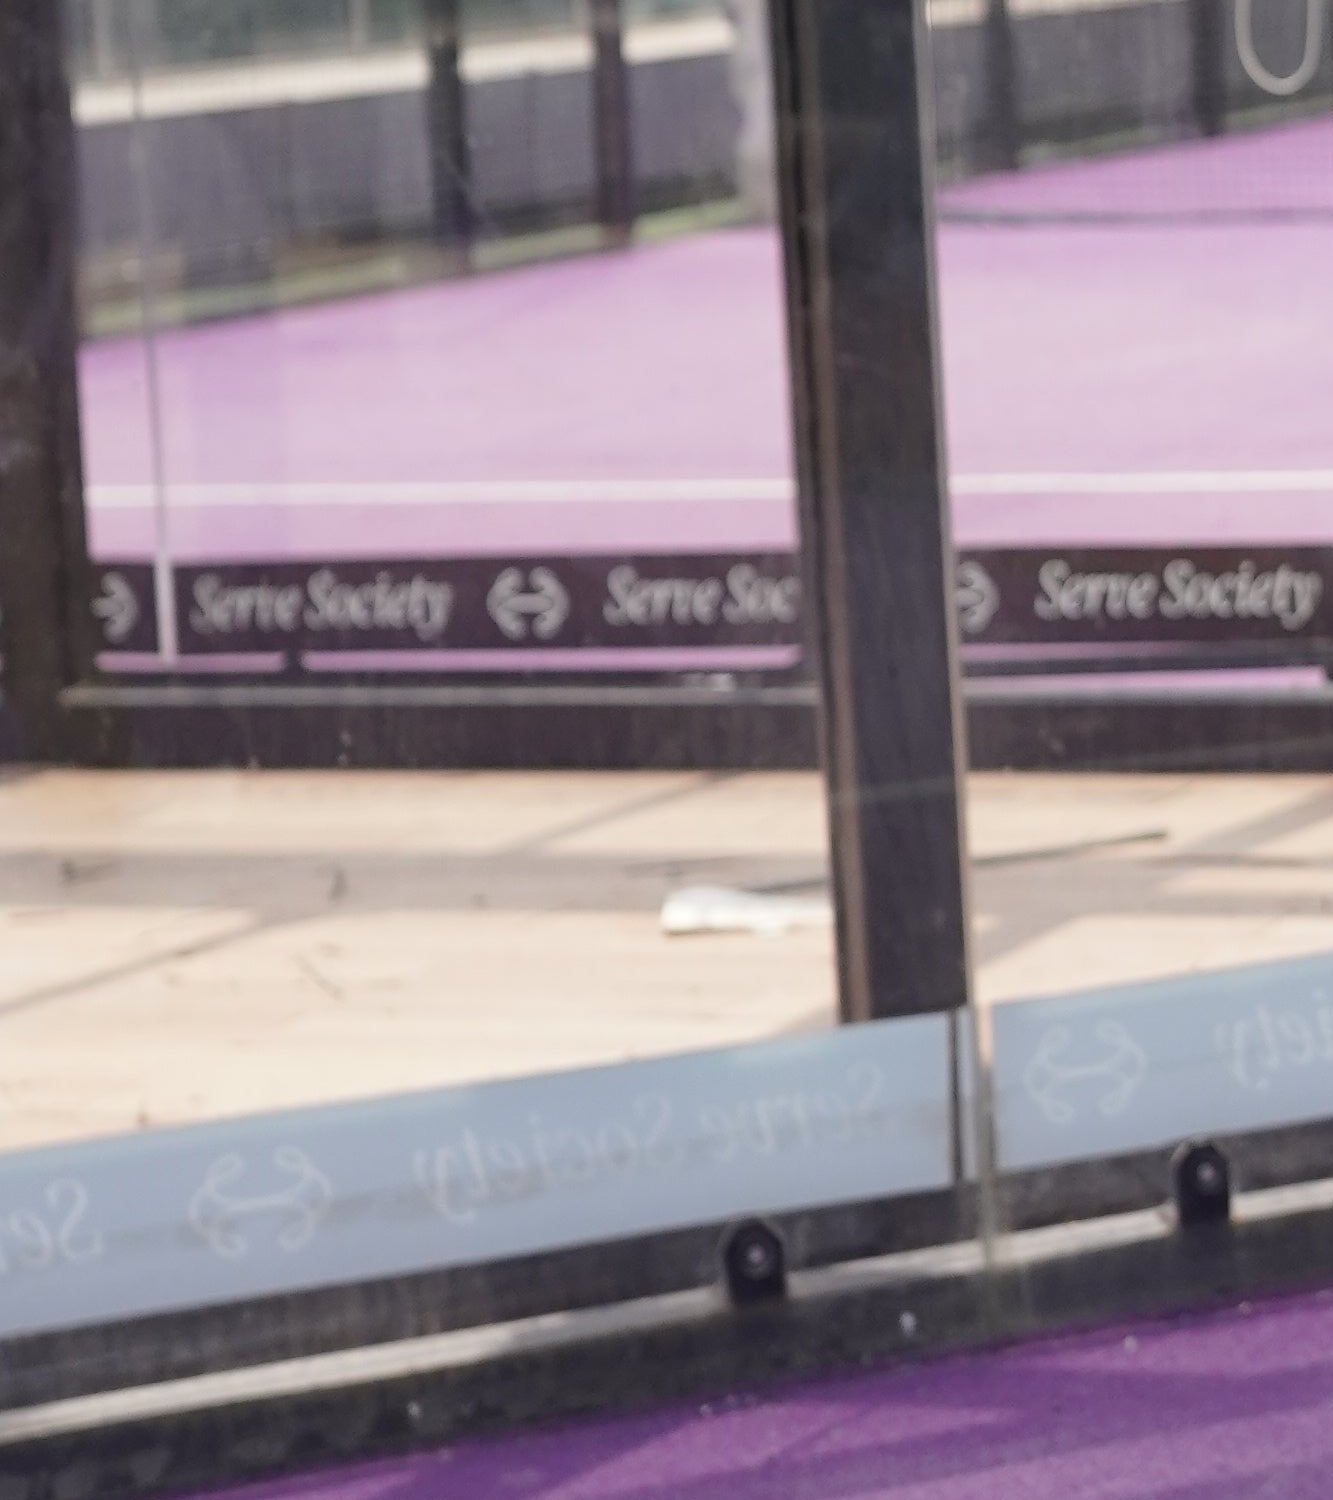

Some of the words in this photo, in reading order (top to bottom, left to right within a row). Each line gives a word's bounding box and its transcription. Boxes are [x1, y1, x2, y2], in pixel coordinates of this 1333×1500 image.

[190, 570, 300, 634] Serve
[302, 566, 455, 640] Society
[603, 563, 726, 627] Serve
[1034, 559, 1158, 621] Serve
[1158, 558, 1323, 631] Society
